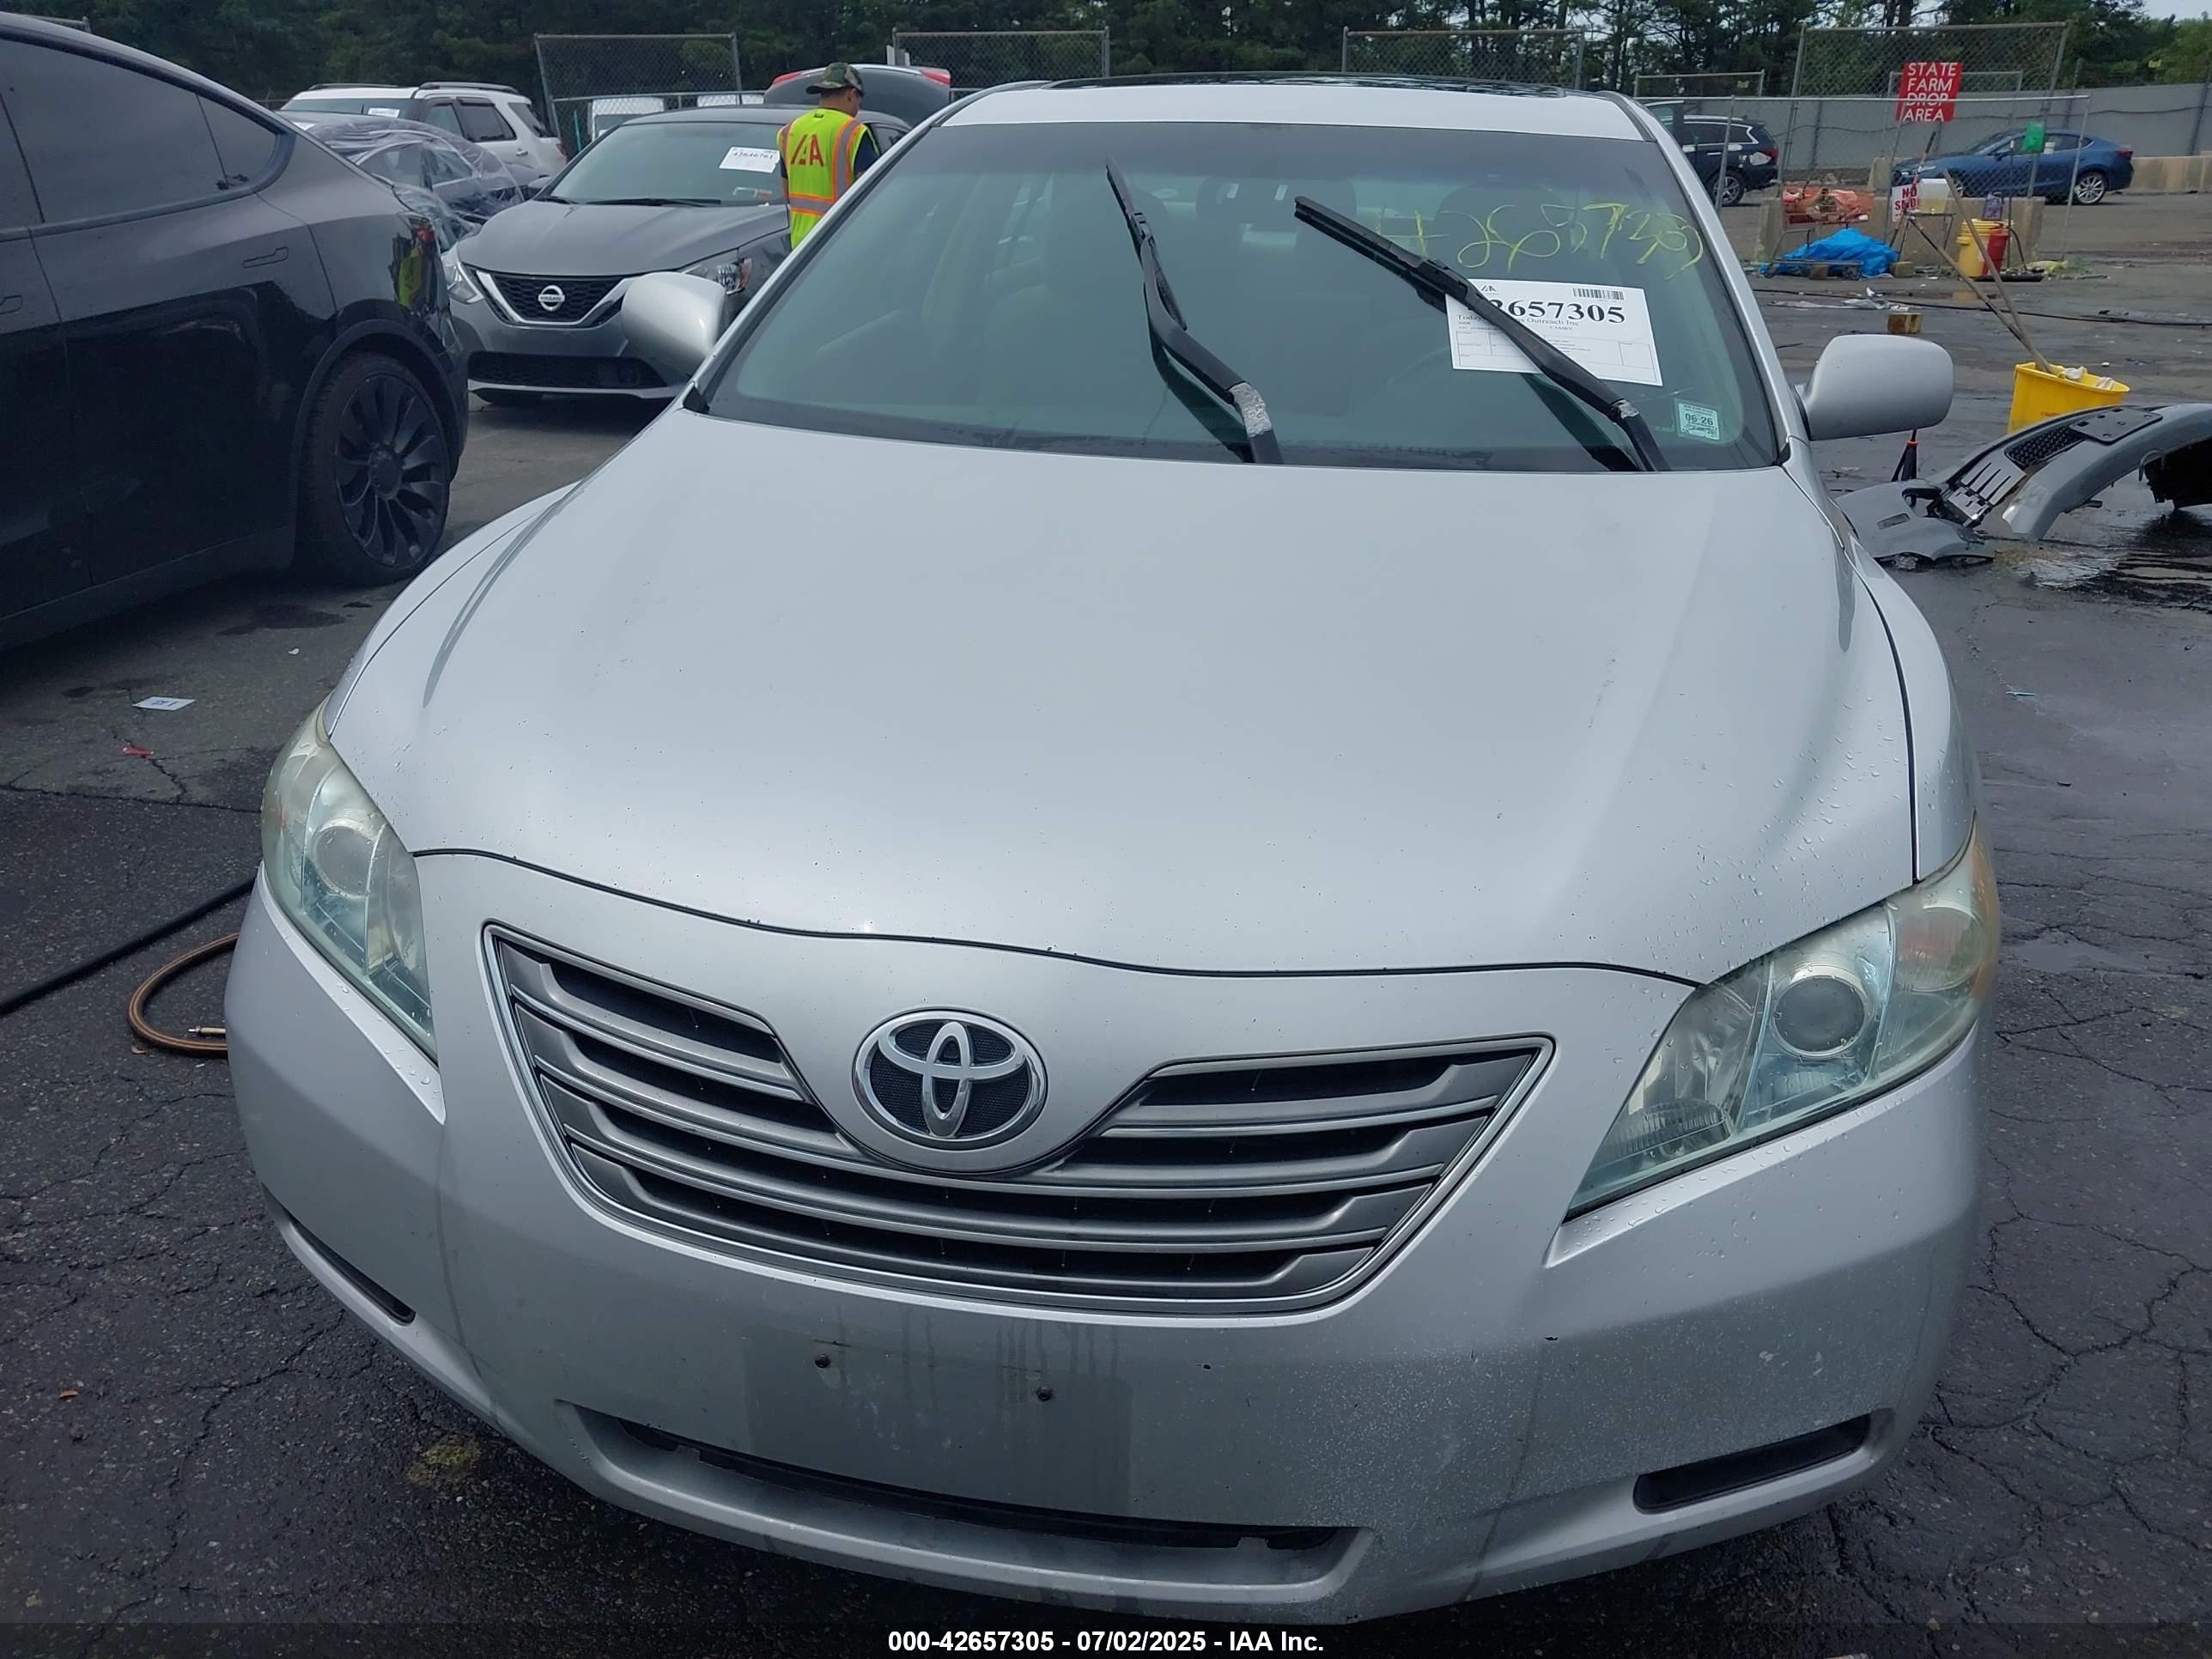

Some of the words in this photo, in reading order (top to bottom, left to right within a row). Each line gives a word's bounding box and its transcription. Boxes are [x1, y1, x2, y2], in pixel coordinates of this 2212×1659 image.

[1907, 62, 1958, 76] STATE
[1907, 77, 1954, 92] FARM
[1905, 92, 1949, 106] DROP
[1903, 108, 1945, 123] AREA
[1902, 185, 1917, 199] NO
[1488, 299, 1626, 324] 657305
[1686, 413, 1698, 422] 06
[1700, 416, 1714, 426] 26
